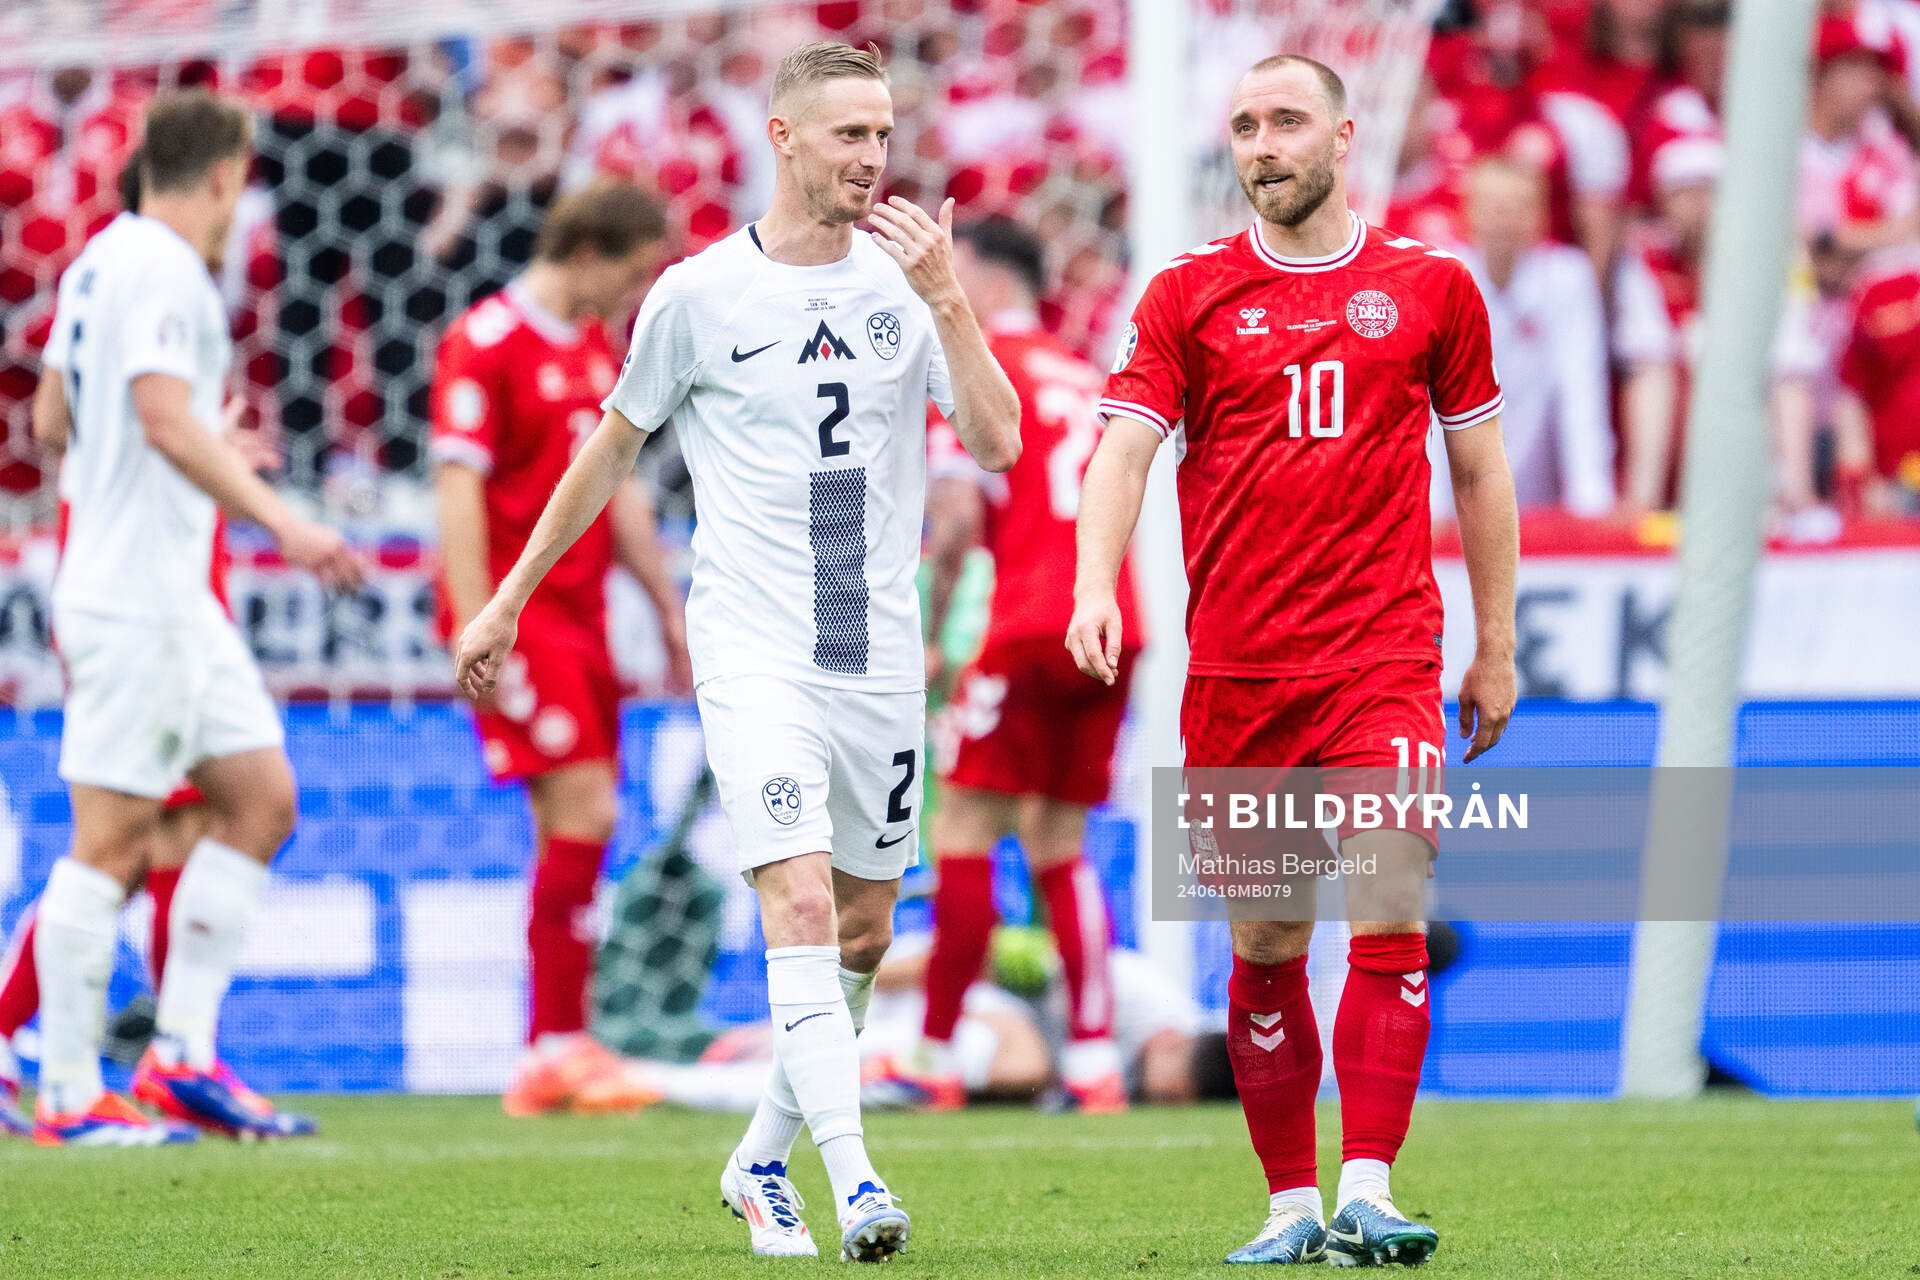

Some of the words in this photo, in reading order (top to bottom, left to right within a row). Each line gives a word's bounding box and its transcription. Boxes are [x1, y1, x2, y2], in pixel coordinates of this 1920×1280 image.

[1236, 324, 1269, 335] hummel
[1357, 305, 1388, 320] DBU
[816, 382, 850, 458] 2
[1283, 360, 1345, 438] 10
[886, 749, 916, 823] 2
